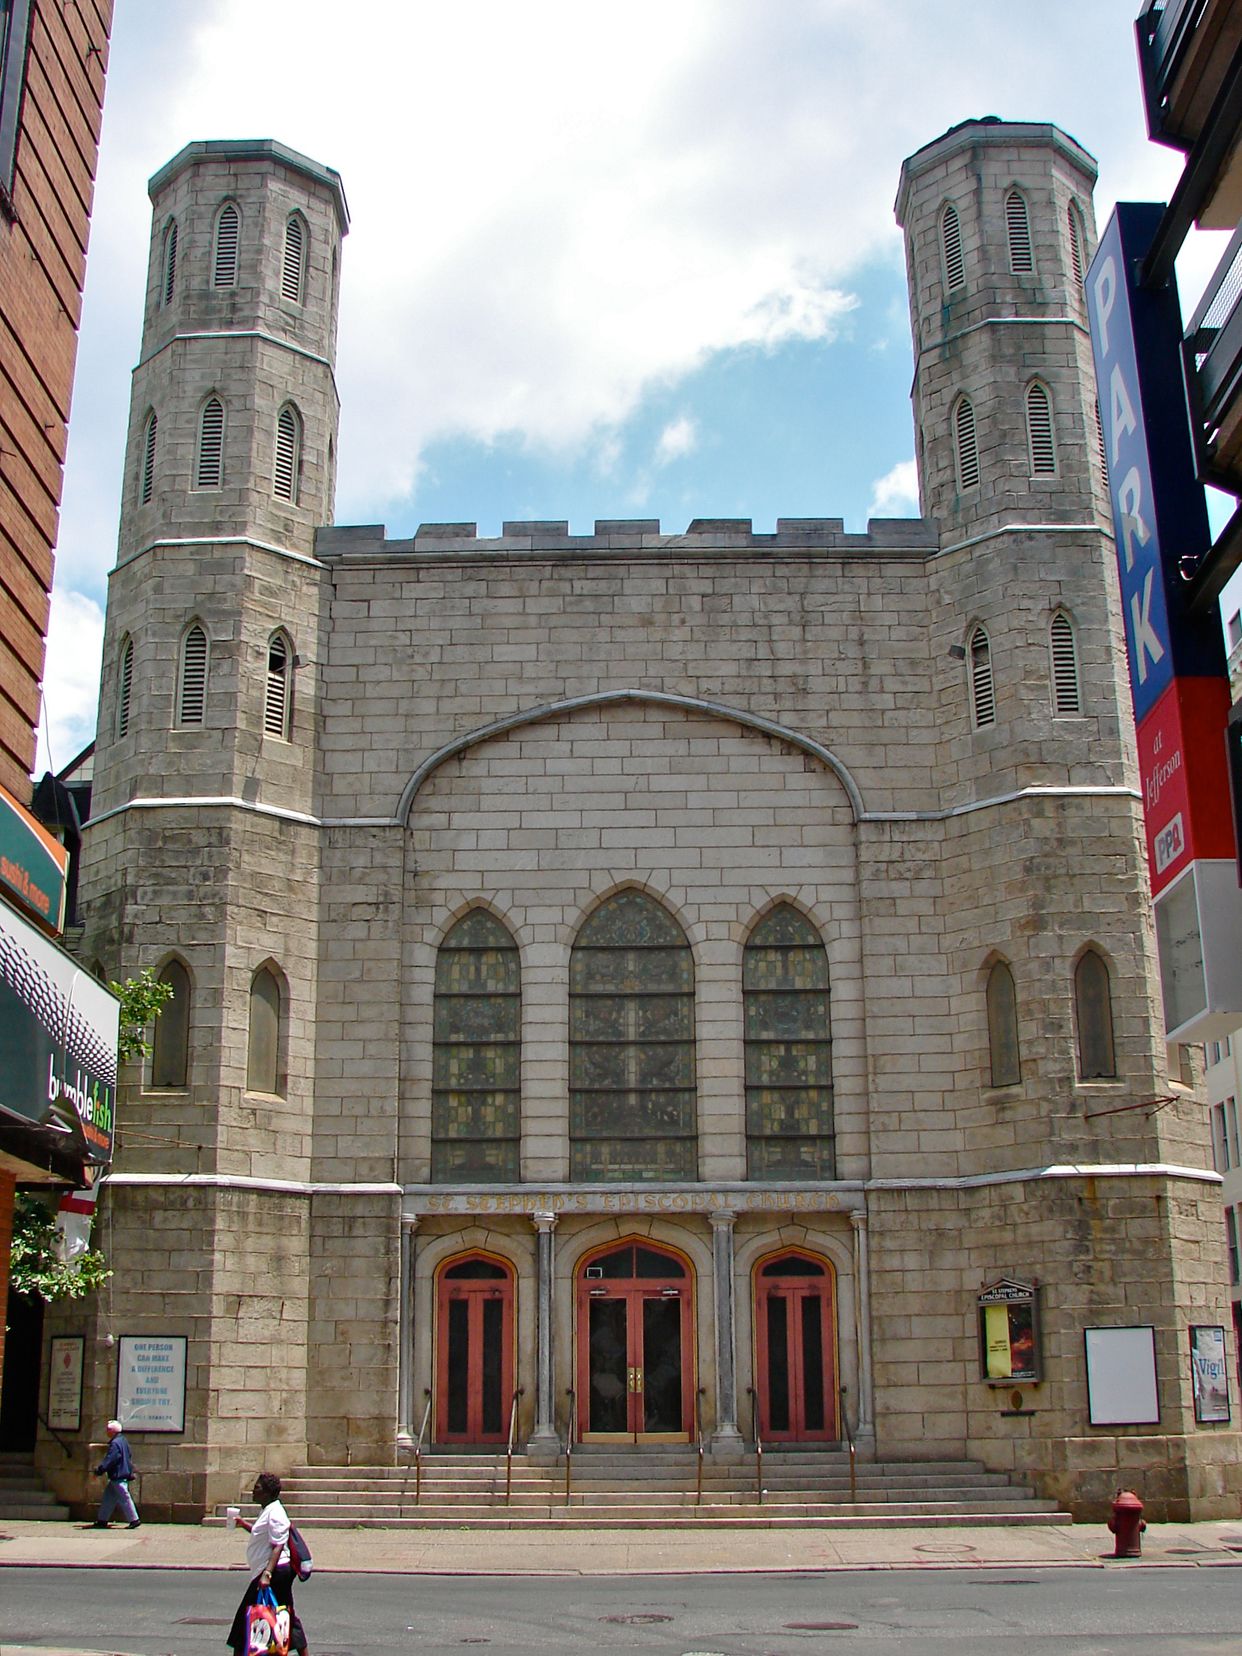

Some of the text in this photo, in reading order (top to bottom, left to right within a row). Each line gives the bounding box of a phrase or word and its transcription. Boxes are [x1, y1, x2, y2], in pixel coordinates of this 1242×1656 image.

[1093, 255, 1165, 687] PARK
[1153, 730, 1162, 755] at
[1145, 750, 1181, 812] Jefferson
[1157, 822, 1182, 866] PPA
[0, 855, 24, 891] sushi
[29, 882, 50, 915] more
[600, 1192, 736, 1211] EPISCOPAL
[747, 1191, 841, 1210] CHURCH
[148, 1343, 174, 1351] PERSON
[1199, 1358, 1224, 1380] Vigil
